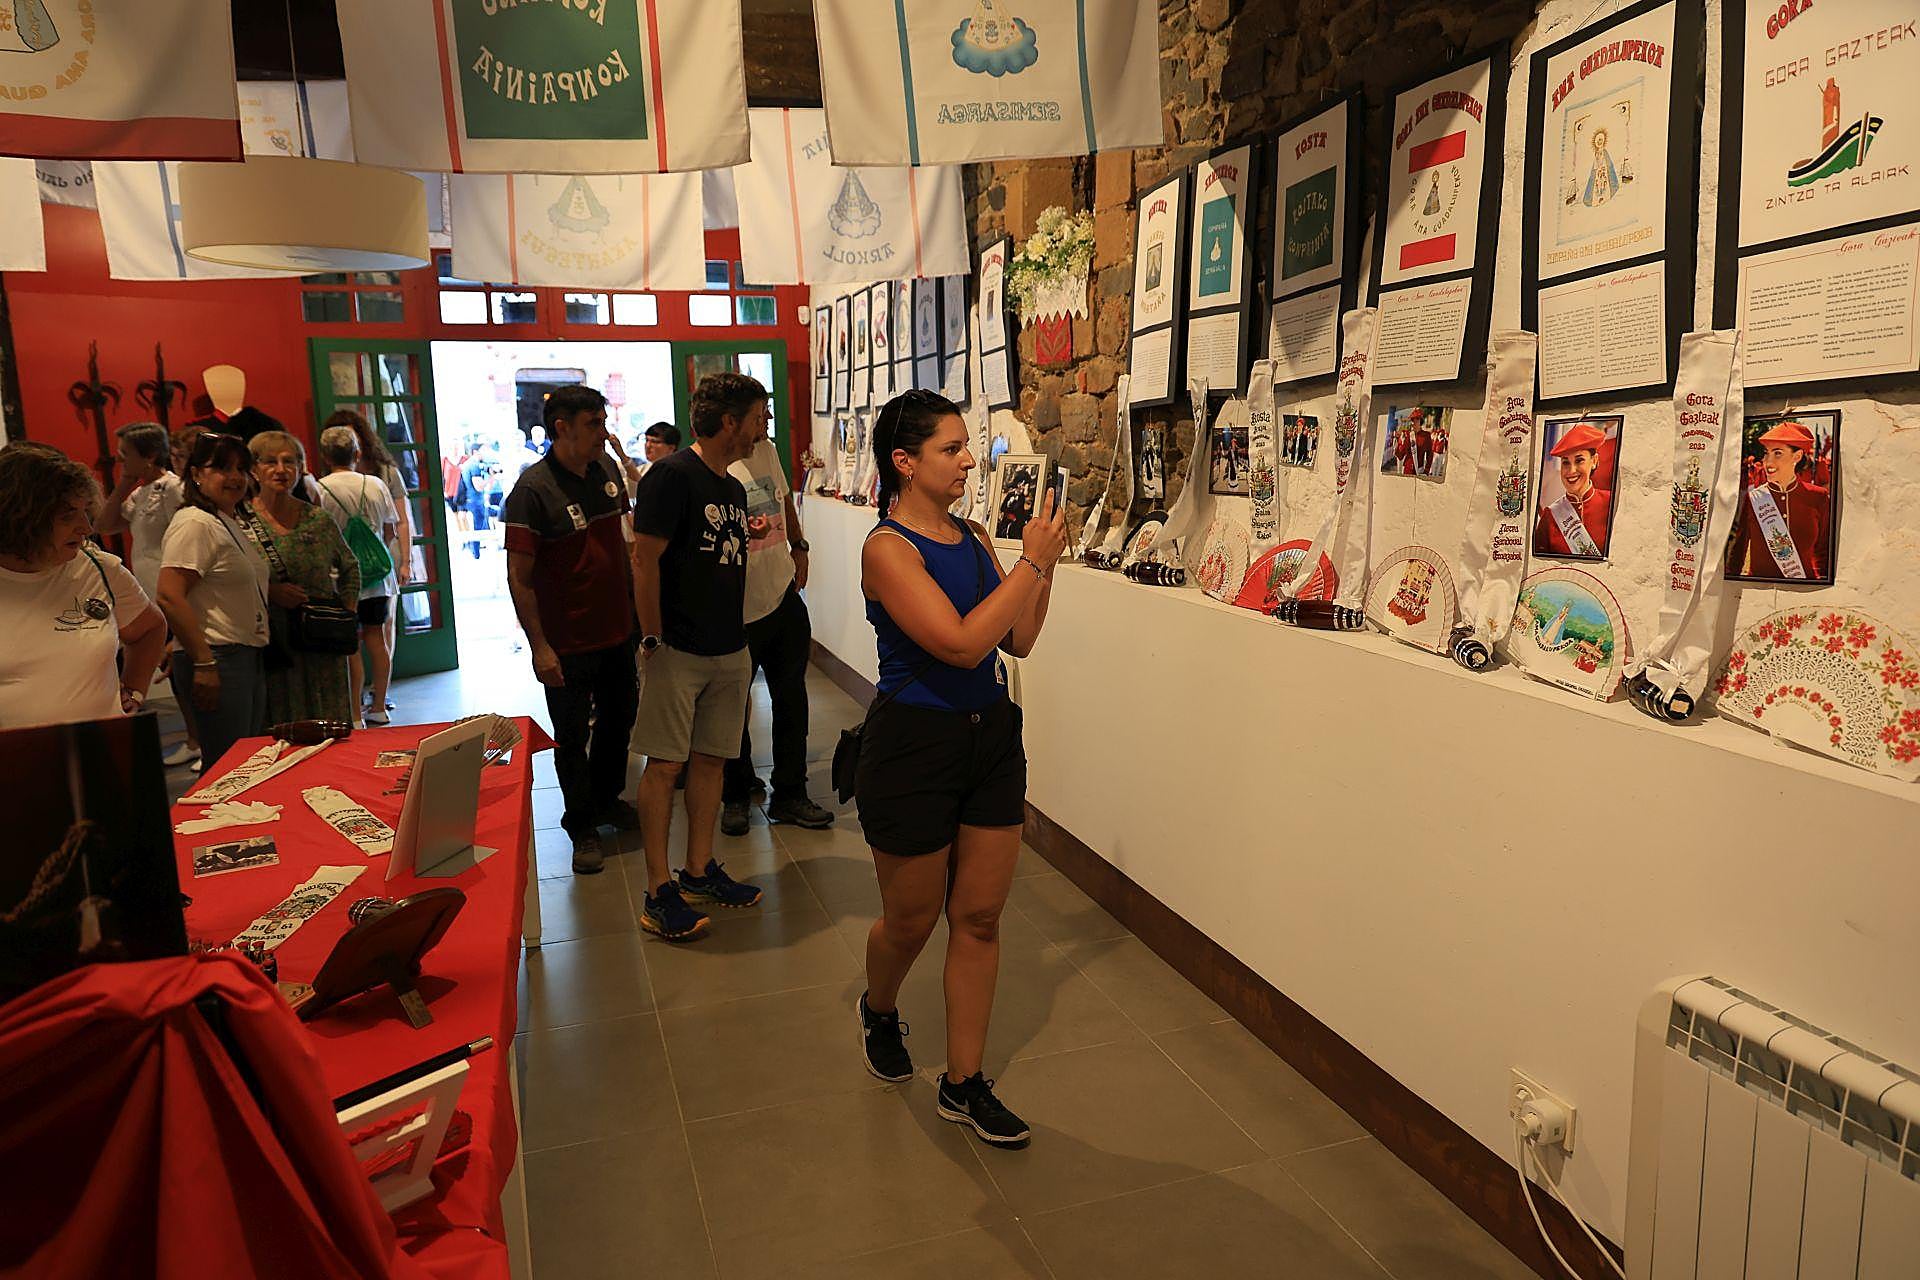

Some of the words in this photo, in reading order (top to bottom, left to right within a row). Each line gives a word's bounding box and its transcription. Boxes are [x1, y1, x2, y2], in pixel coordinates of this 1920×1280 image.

[1765, 57, 1809, 88] GORA
[1826, 19, 1916, 67] GAZTEAK
[1295, 131, 1328, 160] KOSTA
[1765, 188, 1815, 209] ZINTZO
[1824, 182, 1841, 194] TA
[1851, 165, 1910, 187] ALAIAK
[1686, 393, 1714, 406] Gora
[700, 531, 717, 551] LE
[1849, 756, 1878, 769] ELENA
